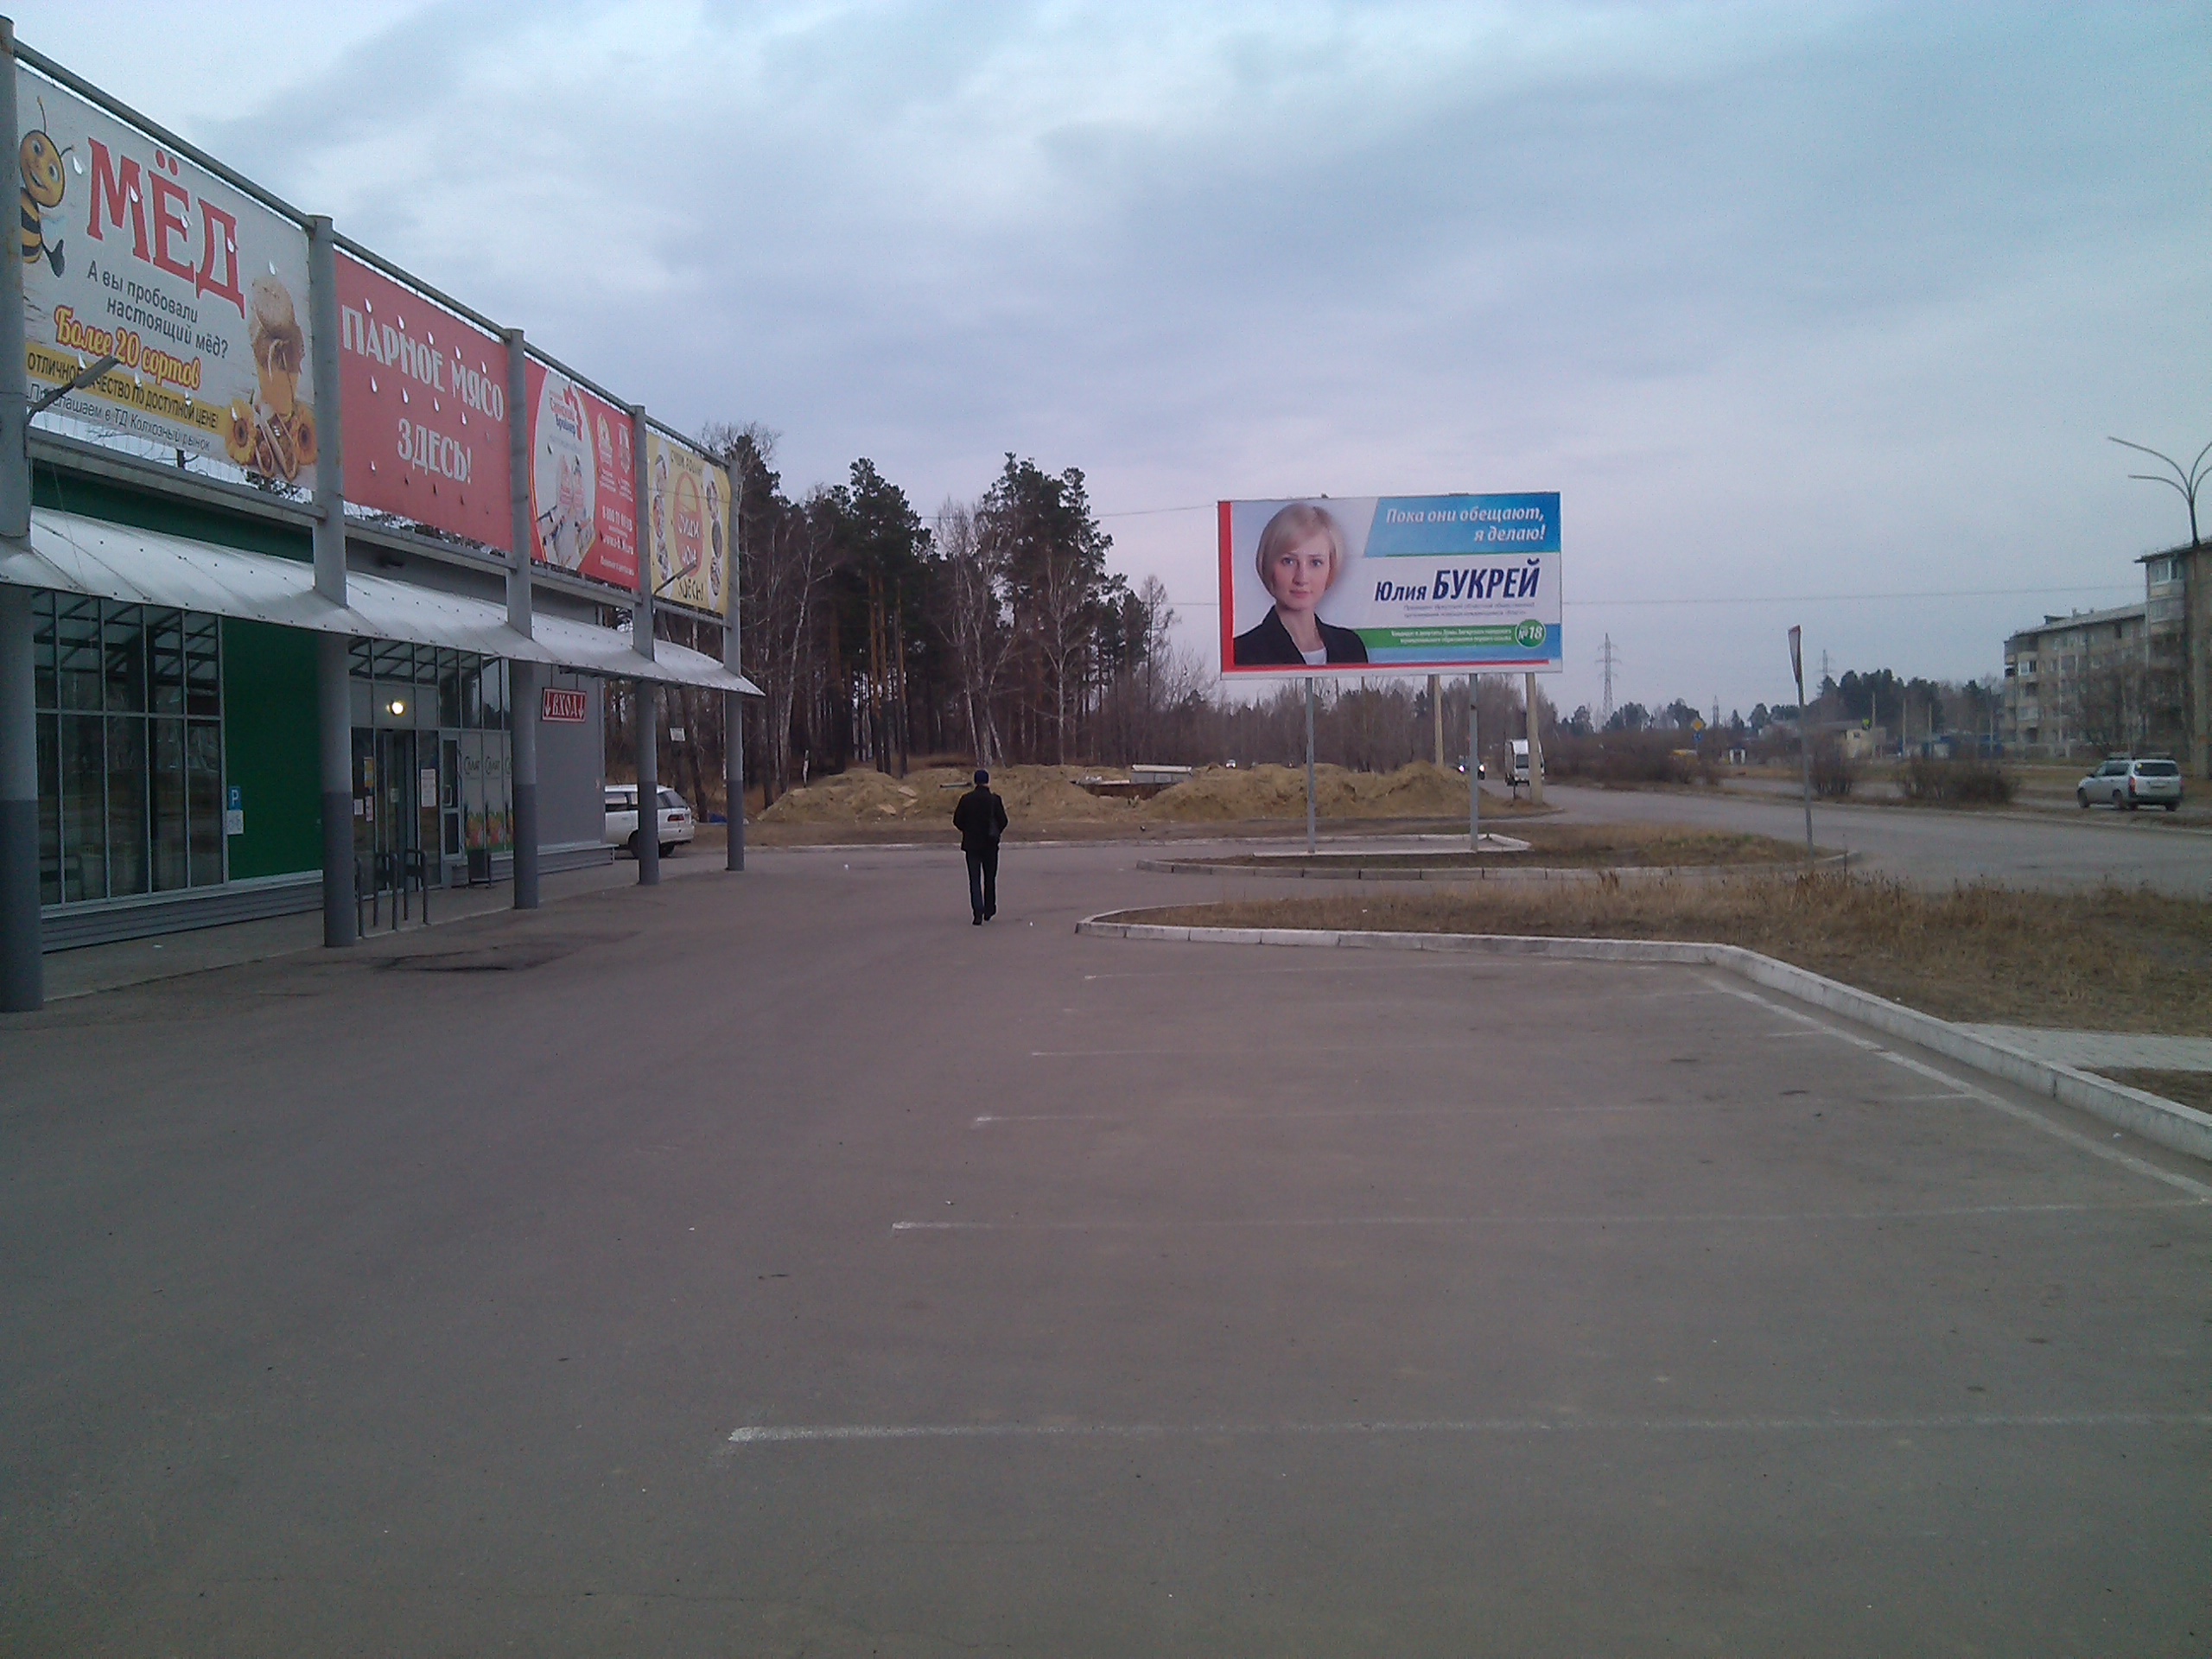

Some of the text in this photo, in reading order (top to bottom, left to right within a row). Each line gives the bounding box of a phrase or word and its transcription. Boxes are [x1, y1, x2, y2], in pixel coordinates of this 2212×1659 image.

[87, 137, 245, 320] МЁД
[87, 260, 199, 324] А вы пробовали
[54, 305, 203, 391] Более 20 сортов
[107, 297, 229, 359] настоящий мёд?
[342, 304, 505, 422] ПАРНОЕ МЯСО
[114, 407, 129, 428] ТД
[130, 413, 181, 442] Колхозный
[131, 385, 145, 404] ПО
[397, 417, 472, 484] ЗДЕСЬ!
[1386, 505, 1544, 524] Пока они обещают,
[1474, 524, 1546, 543] я делаю!
[1375, 557, 1541, 601] Юлия БУКРЕЙ
